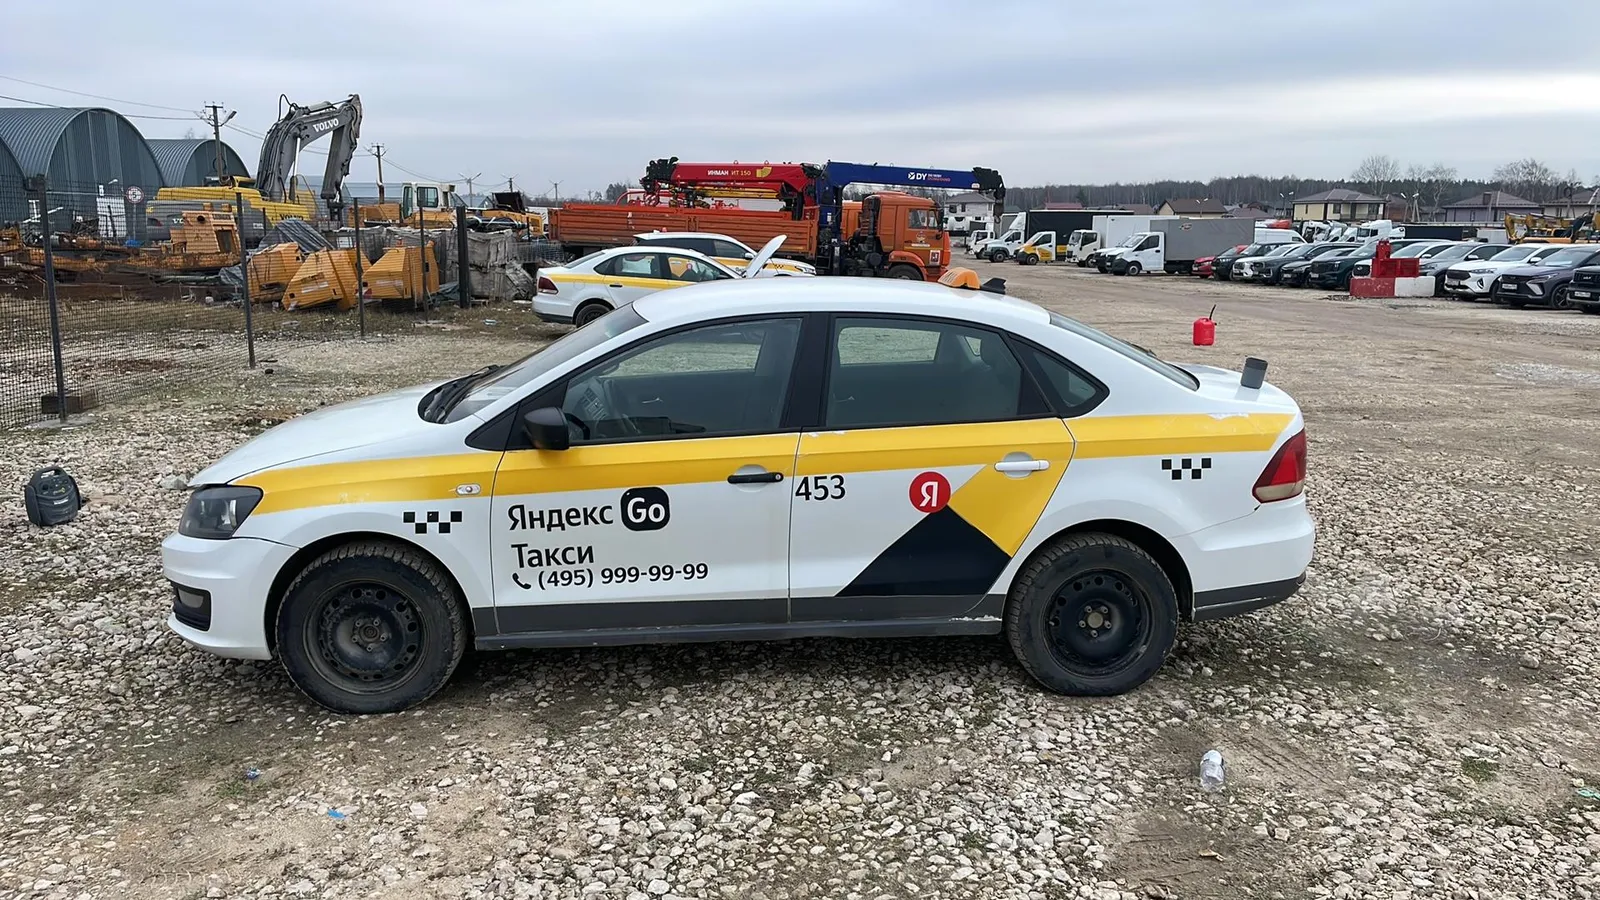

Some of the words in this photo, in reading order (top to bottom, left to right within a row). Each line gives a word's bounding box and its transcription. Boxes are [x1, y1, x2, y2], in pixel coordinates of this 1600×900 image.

[312, 118, 339, 132] VOLVO
[916, 172, 928, 181] DY
[795, 475, 846, 501] 453
[919, 481, 939, 507] Я
[508, 504, 614, 532] Яндекс
[627, 497, 666, 523] Go
[511, 543, 594, 568] Такси
[538, 568, 594, 590] (495)
[600, 563, 709, 584] 999-99-99
